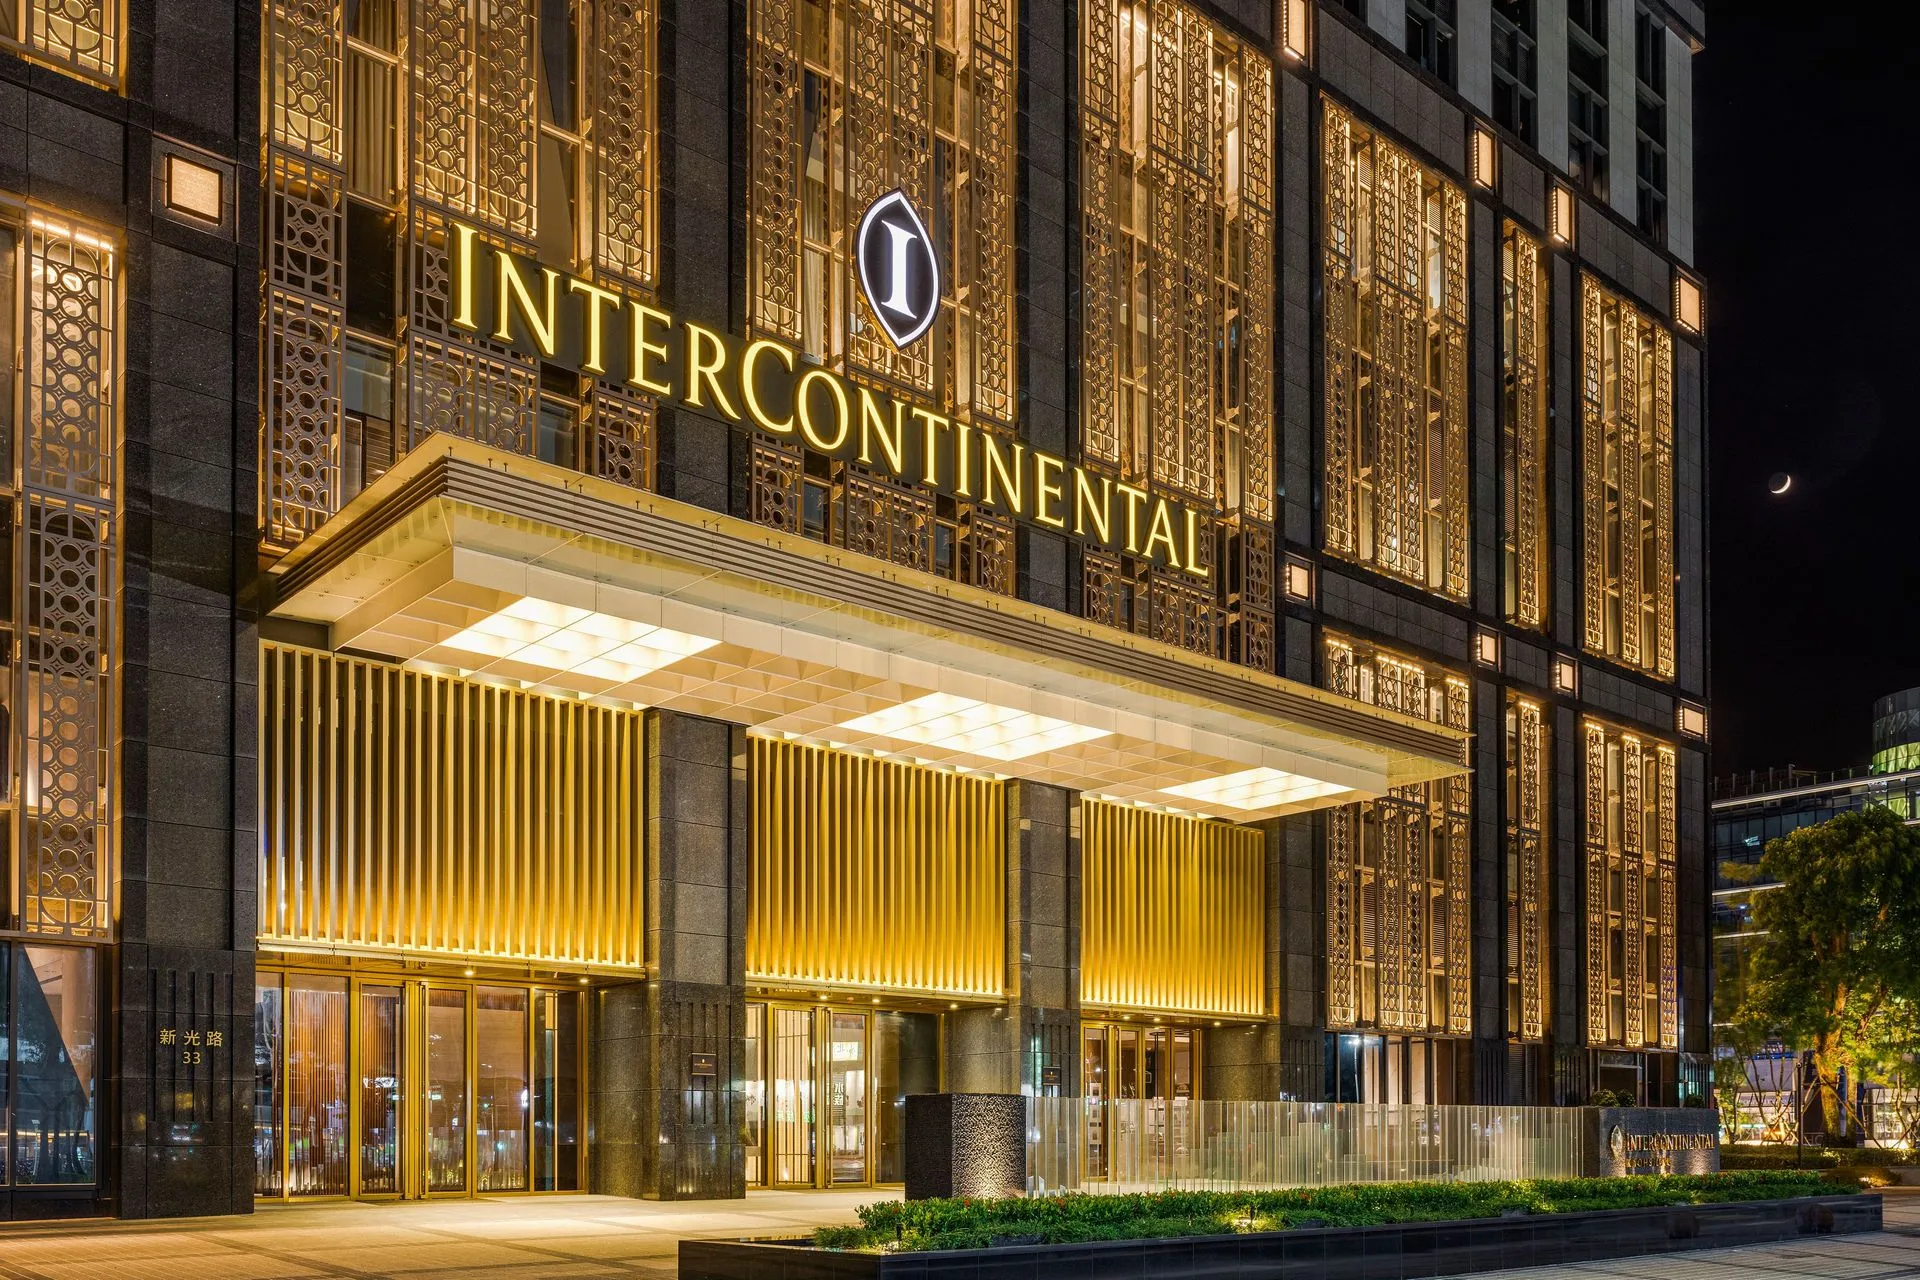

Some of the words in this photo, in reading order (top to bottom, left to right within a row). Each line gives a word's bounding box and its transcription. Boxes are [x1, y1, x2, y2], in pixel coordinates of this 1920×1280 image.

[881, 219, 917, 318] I
[450, 222, 1210, 577] INTERCONTINENTAL
[160, 1028, 223, 1047] 新光路
[183, 1051, 201, 1065] 33
[1627, 1132, 1715, 1151] INTERCONTINENTAL
